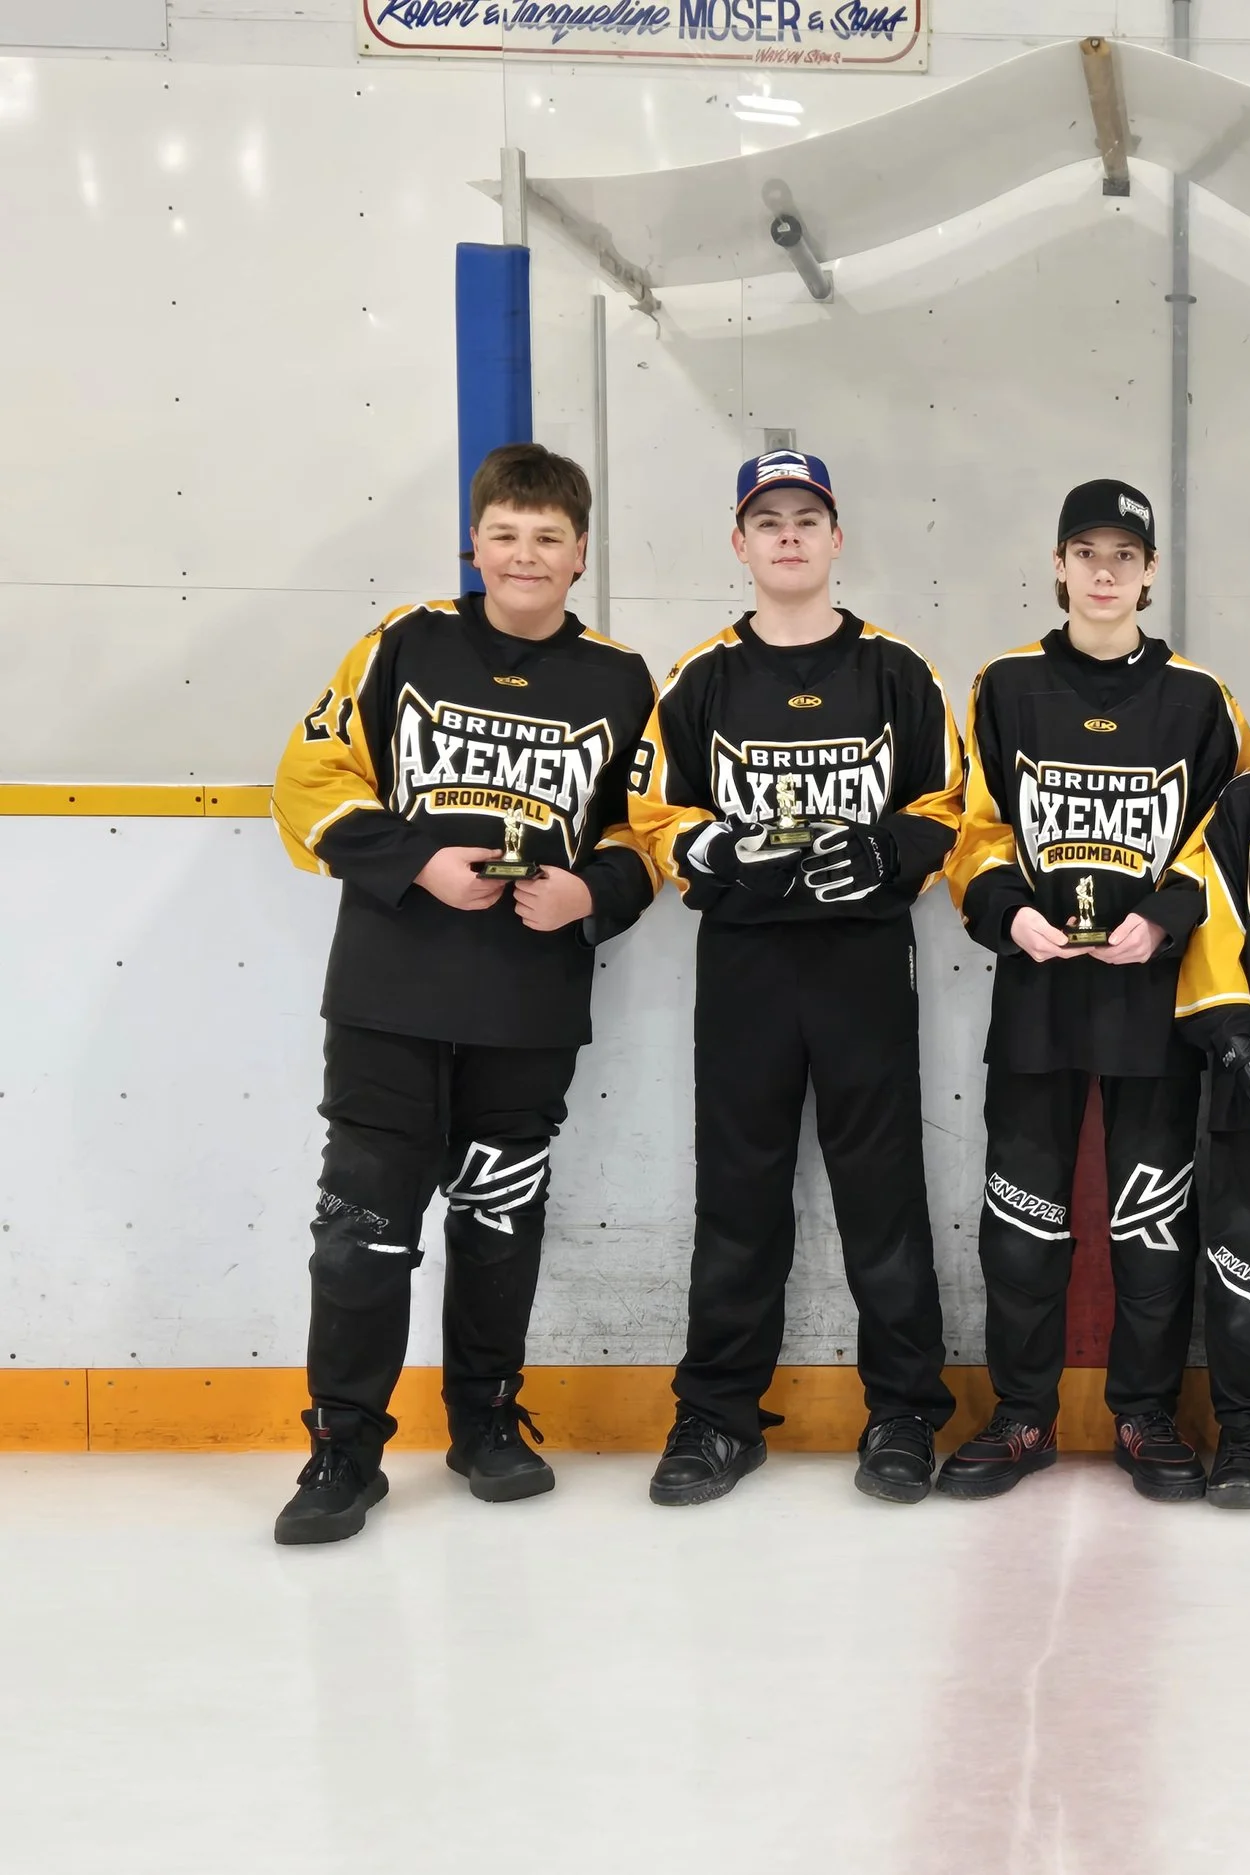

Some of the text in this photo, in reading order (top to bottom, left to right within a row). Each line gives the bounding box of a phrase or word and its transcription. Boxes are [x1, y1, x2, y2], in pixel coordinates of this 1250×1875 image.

[376, 0, 479, 29] Robert
[503, 0, 670, 44] Jacqueline
[678, 0, 802, 42] MOSER
[829, 0, 907, 41] Sons
[302, 687, 354, 748] 21
[442, 710, 560, 745] BRUNO
[396, 703, 604, 838] AXEMEN
[751, 746, 860, 768] BRUNO
[1044, 769, 1149, 792] BRUNO
[434, 791, 544, 822] BROOMBALL
[1019, 771, 1180, 884] AXEMEN
[1047, 845, 1139, 870] BROOMBALL
[988, 1172, 1067, 1225] KNAPPER
